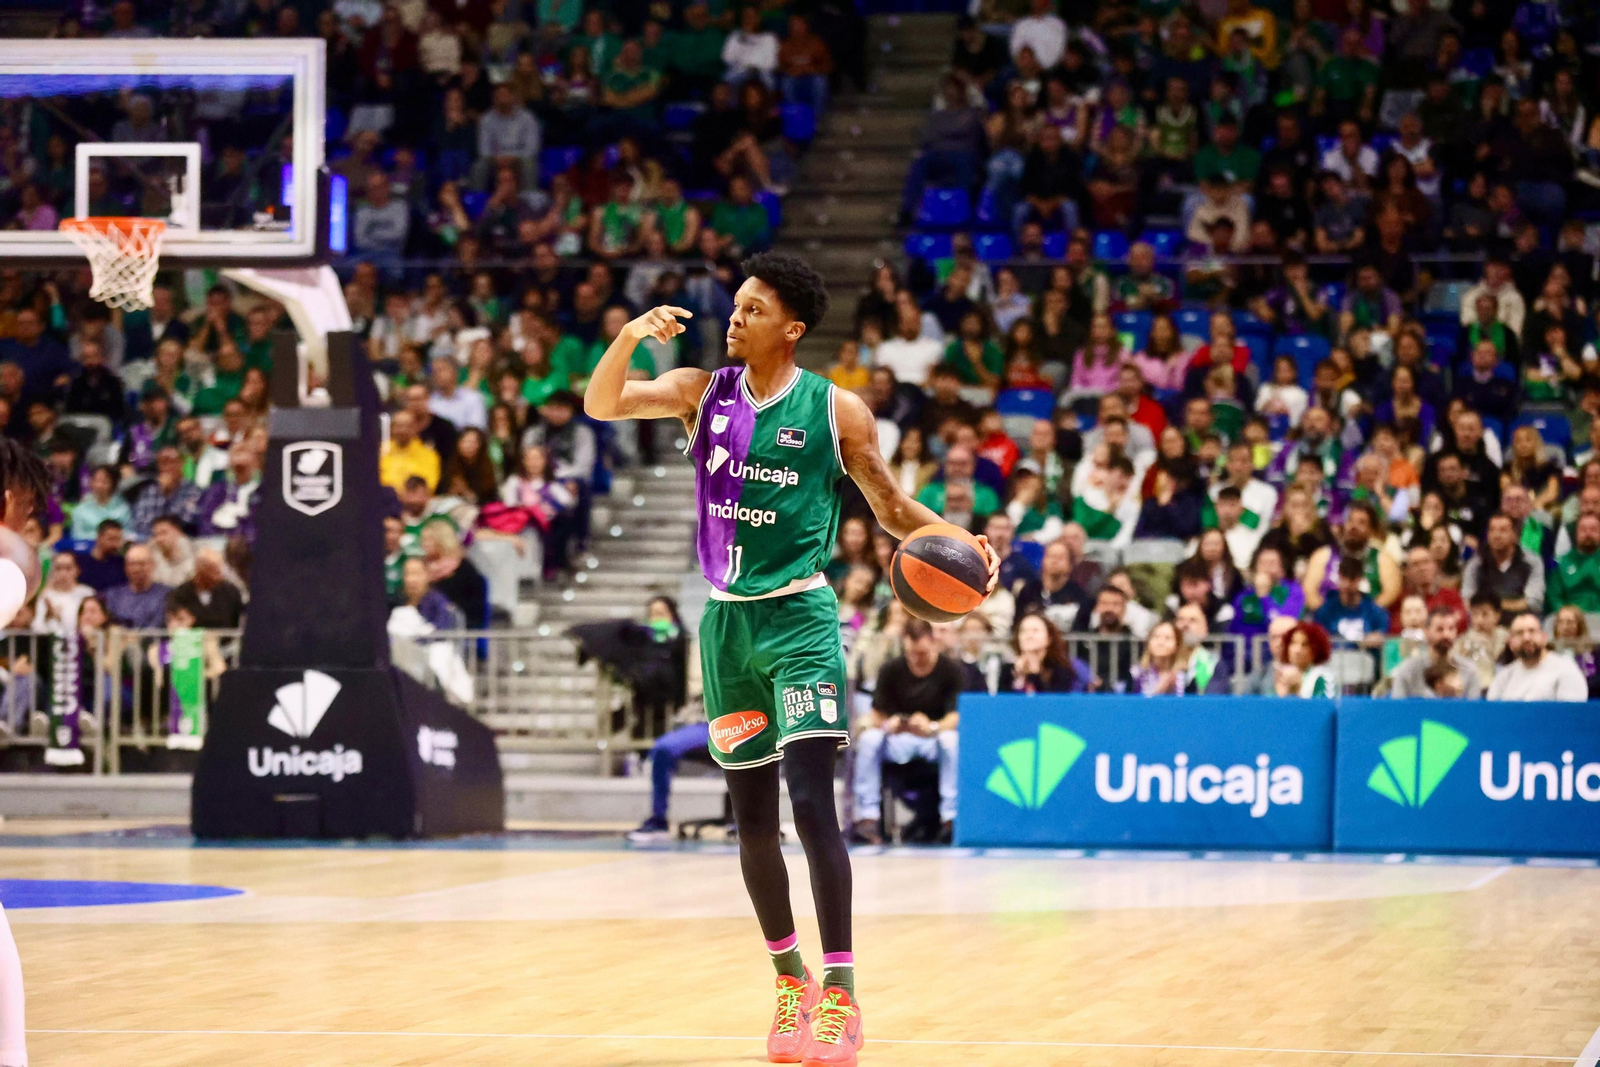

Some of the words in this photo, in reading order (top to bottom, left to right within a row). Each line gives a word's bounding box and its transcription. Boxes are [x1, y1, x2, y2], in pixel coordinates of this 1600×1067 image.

[729, 460, 799, 488] Unicaja
[722, 545, 742, 584] 11
[248, 745, 363, 783] Unicaja
[1094, 752, 1304, 818] Unicaja
